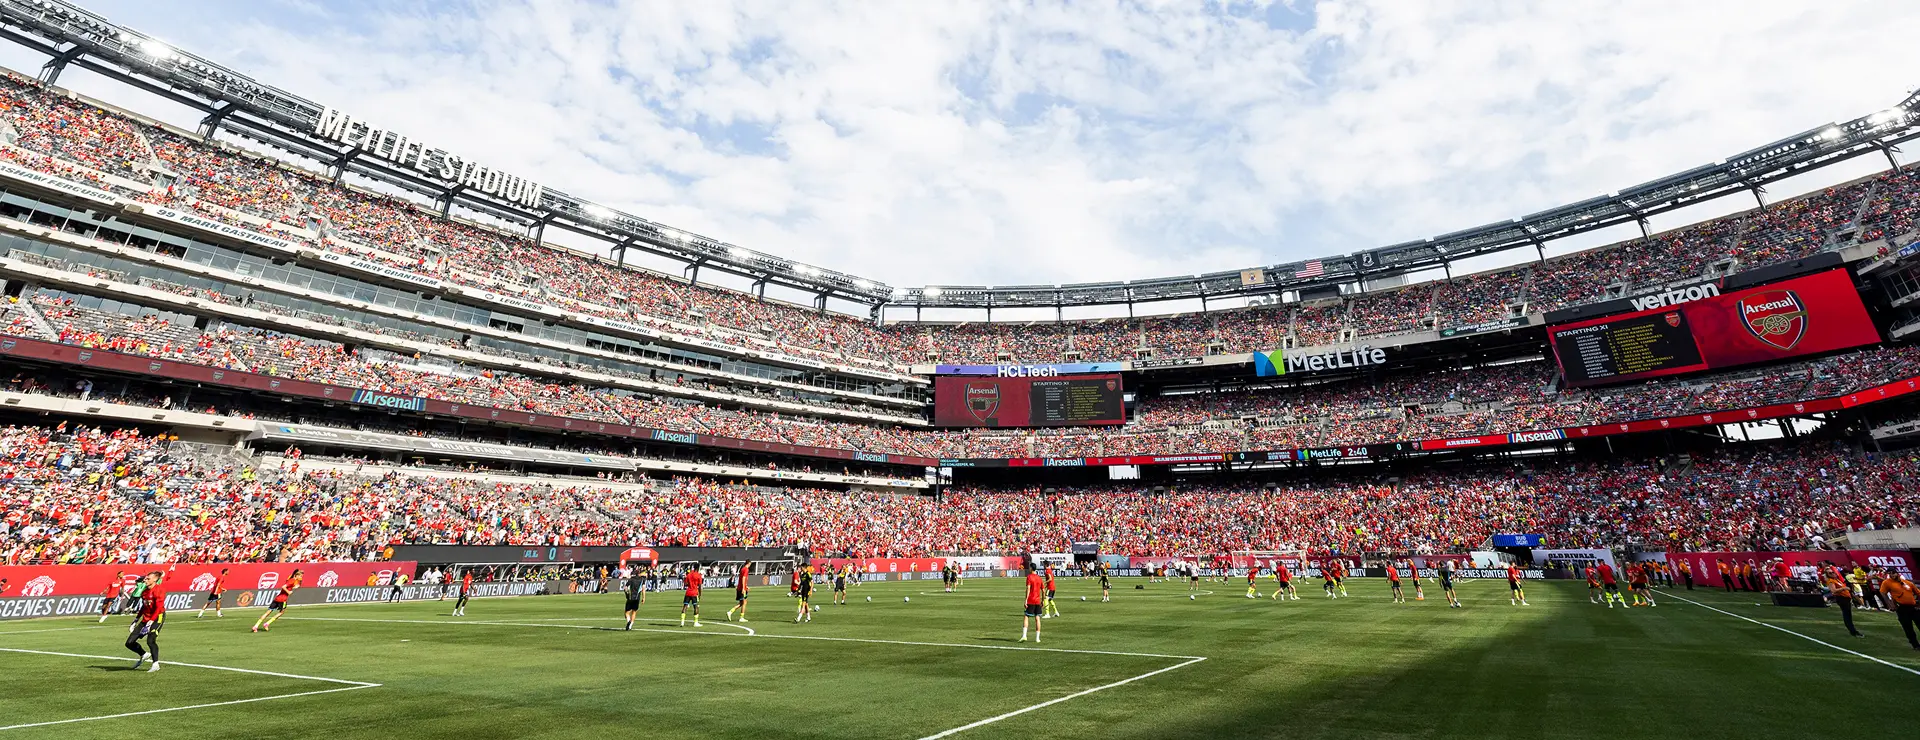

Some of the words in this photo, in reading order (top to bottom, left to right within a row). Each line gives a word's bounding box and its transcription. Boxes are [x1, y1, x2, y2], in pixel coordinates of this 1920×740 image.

[315, 104, 431, 172] METLIFE
[439, 151, 543, 208] STADIUM
[48, 179, 117, 202] FERGUSON
[156, 209, 176, 218] 99
[180, 216, 219, 230] MARK
[221, 227, 288, 248] GASTINEAU
[324, 253, 339, 261] 60
[350, 260, 384, 272] LARRY
[384, 269, 438, 286] GRANTHAM
[1630, 282, 1720, 311] verizon
[500, 298, 522, 307] LEON
[522, 302, 542, 311] HESS
[1745, 296, 1793, 315] Arsenal
[604, 321, 636, 332] WINSTON
[1476, 321, 1519, 332] CHAMPIONS
[1556, 326, 1599, 338] STARTING
[1287, 344, 1387, 373] MetLife
[997, 365, 1057, 377] HCLTech
[969, 387, 996, 395] Arsenal
[361, 391, 416, 410] Arsenal
[298, 429, 338, 438] MetLife
[657, 430, 692, 443] Arsenal
[1515, 430, 1557, 443] Arsenal
[429, 441, 472, 452] METLIFE
[473, 445, 514, 455] STADIUM
[1310, 449, 1342, 458] MetLife
[1347, 447, 1367, 456] 2:40
[859, 452, 884, 462] Arsenal
[1049, 458, 1081, 466] Arsenal
[549, 547, 556, 560] 0
[1868, 556, 1906, 567] OLD
[1350, 568, 1366, 577] MUTV
[1525, 569, 1545, 579] MORE
[326, 587, 380, 602] EXCLUSIVE
[507, 583, 527, 595] AND
